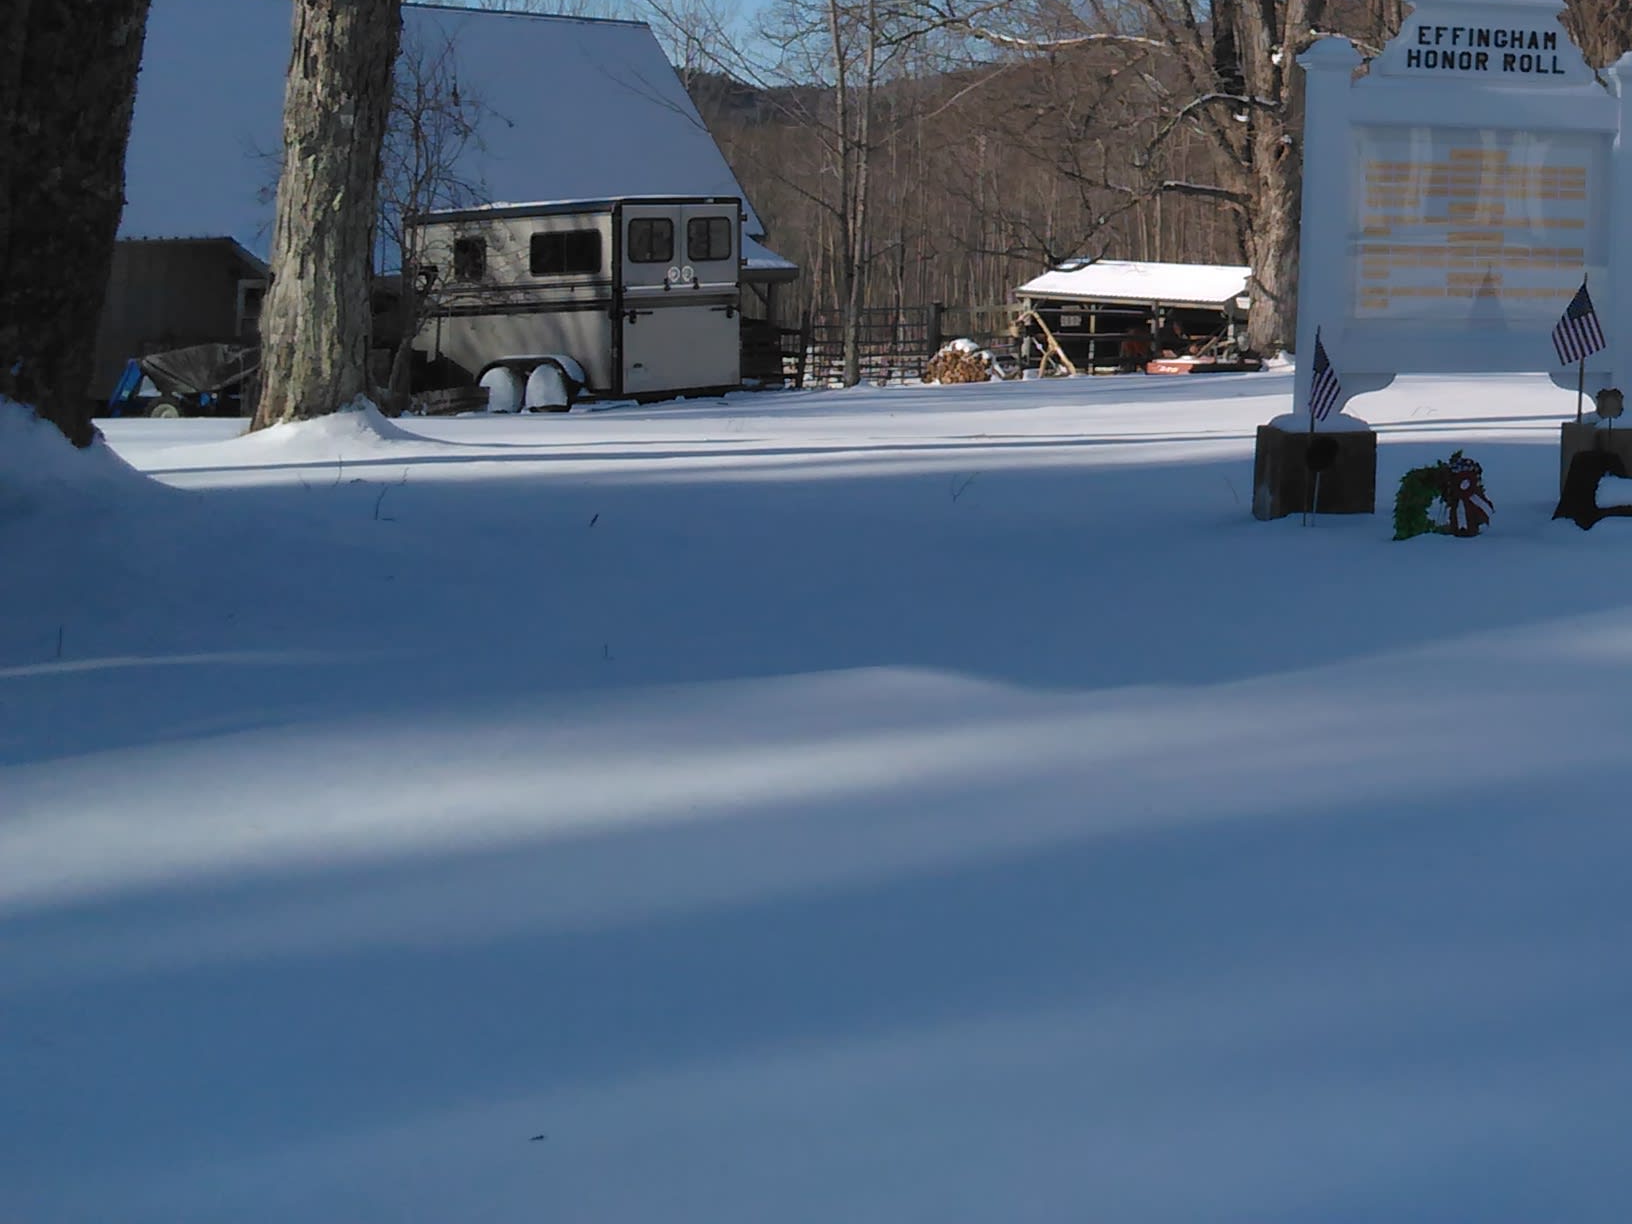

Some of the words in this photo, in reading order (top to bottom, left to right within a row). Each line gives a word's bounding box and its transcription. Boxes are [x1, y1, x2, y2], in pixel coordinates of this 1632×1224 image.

[1418, 26, 1557, 51] EFFINGHAM
[1407, 49, 1489, 71] HONOR
[1503, 53, 1566, 75] ROLL
